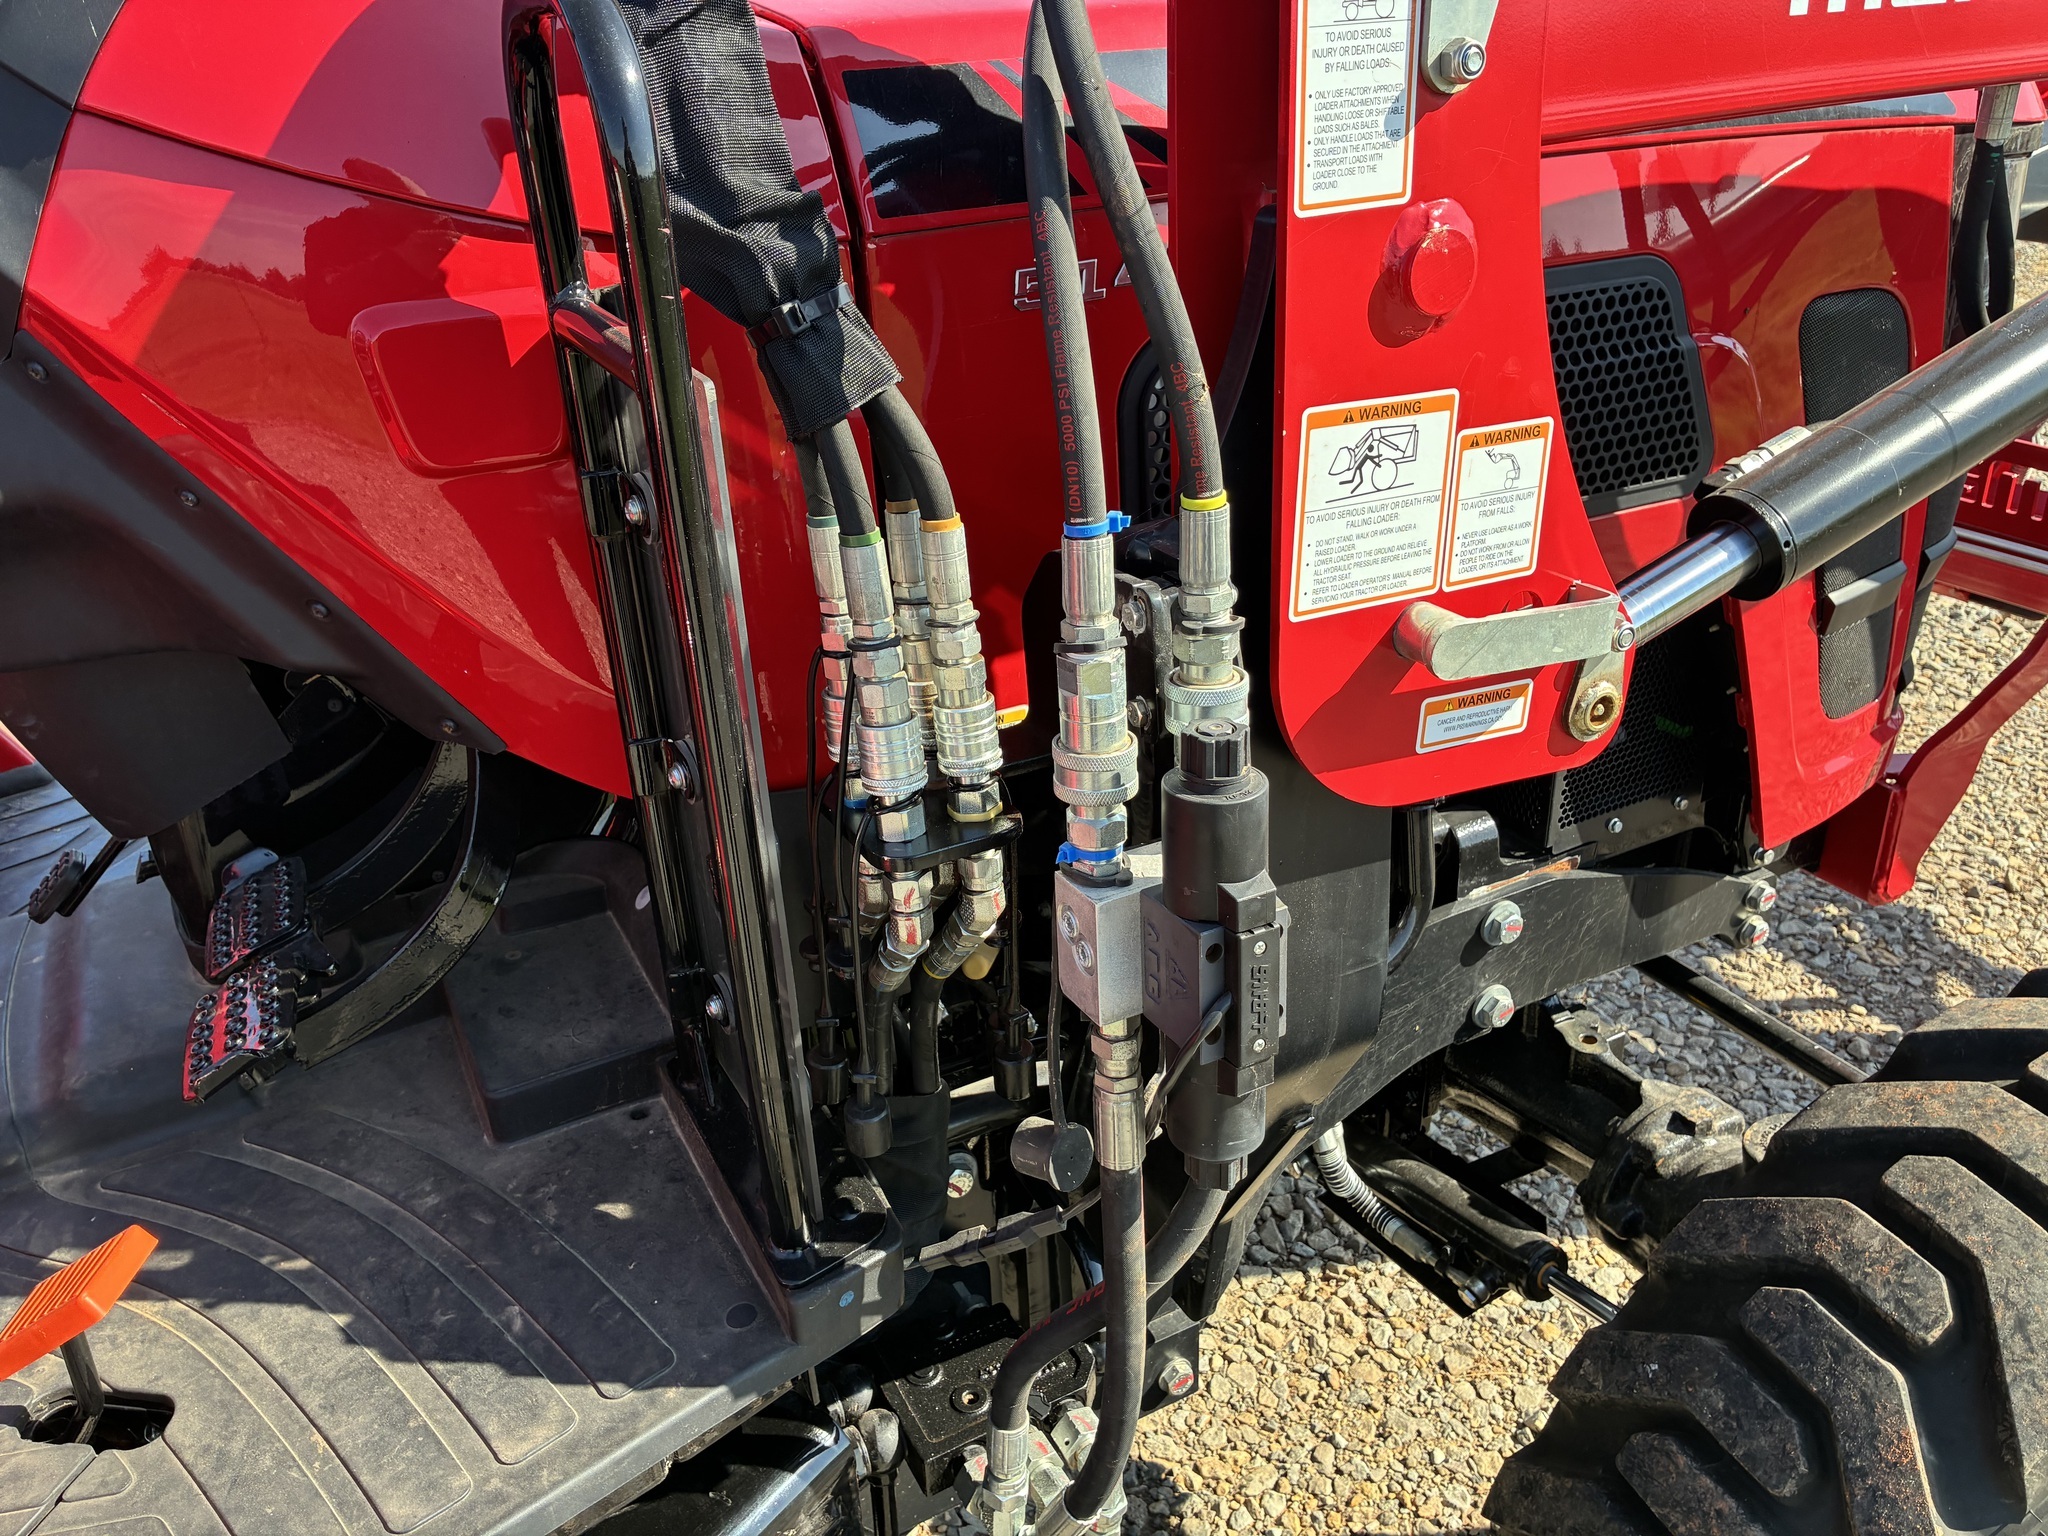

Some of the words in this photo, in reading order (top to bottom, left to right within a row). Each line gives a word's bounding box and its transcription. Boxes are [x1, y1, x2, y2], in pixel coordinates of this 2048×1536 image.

[1325, 31, 1335, 42] TO
[1336, 29, 1358, 41] AVOID
[1360, 27, 1391, 39] SERIOUS
[1311, 47, 1337, 59] INJURY
[1338, 46, 1350, 56] OR
[1351, 44, 1375, 55] DEATH
[1375, 41, 1404, 53] CAUSED
[1324, 62, 1334, 73] BY
[1335, 59, 1365, 72] FALLING
[1314, 89, 1331, 100] ONLY
[1331, 88, 1344, 98] USE
[1344, 85, 1372, 96] FACTORY
[1372, 82, 1403, 94] APPROVED
[1314, 100, 1338, 111] LOADER
[1338, 96, 1381, 109] ATTACHMENTS
[1381, 94, 1399, 105] WHEN
[1314, 111, 1343, 123] HANDLING
[1344, 109, 1364, 120] LOOSE
[1364, 108, 1374, 118] OR
[1374, 105, 1404, 117] SHIFTABLE
[1313, 124, 1333, 134] LOADS
[1334, 122, 1350, 132] SUCH
[1351, 121, 1359, 130] AS
[1360, 119, 1379, 129] BALES.
[1313, 135, 1330, 146] ONLY
[1330, 133, 1353, 144] HANDLE
[1354, 131, 1373, 141] LOADS
[1374, 129, 1388, 139] THAT
[1389, 128, 1400, 137] ARE
[1313, 146, 1341, 157] SECURED
[1342, 145, 1347, 154] IN
[1348, 144, 1360, 153] THE
[1313, 156, 1347, 168] TRANSPORT
[1348, 154, 1367, 164] LOADS
[1368, 152, 1382, 162] WITH
[1312, 168, 1336, 180] LOADER
[1337, 166, 1356, 177] CLOSE
[1357, 165, 1365, 174] TO
[1366, 164, 1376, 173] THE
[1040, 250, 1060, 326] Resistant
[1052, 330, 1069, 379] Flame
[1058, 385, 1072, 412] PSI
[1358, 400, 1422, 421] WARNING
[1061, 416, 1076, 452] 5000
[1180, 399, 1202, 468] Resistant
[1484, 425, 1541, 445] WARNING
[1064, 462, 1082, 513] (DN10)
[1305, 515, 1315, 524] TO
[1315, 511, 1336, 522] AVOID
[1337, 506, 1366, 519] SERIOUS
[1366, 502, 1389, 514] INJURY
[1390, 500, 1400, 510] OR
[1400, 497, 1421, 508] DEATH
[1422, 494, 1440, 504] FROM
[1460, 501, 1469, 511] TO
[1469, 498, 1488, 509] AVOID
[1488, 494, 1514, 506] SERIOUS
[1514, 490, 1535, 501] INJURY
[1345, 516, 1372, 529] FALLING
[1372, 511, 1400, 524] LOADER:
[1478, 507, 1496, 518] FROM
[1315, 539, 1323, 547] DO
[1324, 537, 1335, 546] NOT
[1335, 533, 1354, 544] STAND,
[1355, 531, 1369, 540] WALK
[1369, 529, 1378, 537] OR
[1378, 526, 1394, 536] WORK
[1394, 523, 1412, 533] UNDER
[1461, 530, 1478, 540] NEVER
[1478, 528, 1488, 536] USE
[1488, 524, 1507, 535] LOADER
[1507, 523, 1514, 531] AS
[1518, 519, 1532, 529] WORK
[1313, 556, 1332, 567] LOWER
[1333, 552, 1354, 563] LOADER
[1355, 551, 1362, 559] TO
[1362, 549, 1372, 558] THE
[1373, 545, 1395, 556] GROUND
[1395, 543, 1406, 552] AND
[1406, 539, 1427, 549] RELIEVE
[1314, 546, 1334, 557] RAISED
[1459, 549, 1467, 557] DO
[1467, 547, 1477, 555] NOT
[1477, 544, 1493, 554] WORK
[1493, 542, 1506, 550] FROM
[1513, 537, 1530, 547] ALLOW
[1313, 568, 1322, 576] ALL
[1323, 562, 1352, 574] HYDRAULIC
[1352, 557, 1379, 569] PRESSURE
[1380, 553, 1400, 564] BEFORE
[1400, 549, 1422, 560] LEAVING
[1422, 547, 1432, 556] THE
[1458, 555, 1477, 566] PEOPLE
[1484, 552, 1496, 560] RIDE
[1496, 550, 1504, 558] ON
[1504, 548, 1513, 556] THE
[1478, 562, 1486, 570] OR
[1311, 585, 1329, 595] REFER
[1330, 583, 1337, 592] TO
[1337, 579, 1358, 590] LOADER
[1358, 573, 1390, 586] OPERATOR'S
[1392, 569, 1412, 580] MANUAL
[1412, 565, 1432, 576] BEFORE
[1312, 574, 1337, 586] TRACTOR
[1311, 593, 1338, 605] SERVICING
[1339, 590, 1354, 599] YOUR
[1354, 585, 1378, 596] TRACTOR
[1378, 583, 1386, 592] OR
[1458, 688, 1511, 708] WARNING
[1436, 716, 1456, 726] CANCER
[1455, 714, 1466, 722] AND
[1465, 707, 1499, 720] REPRODUCTIVE
